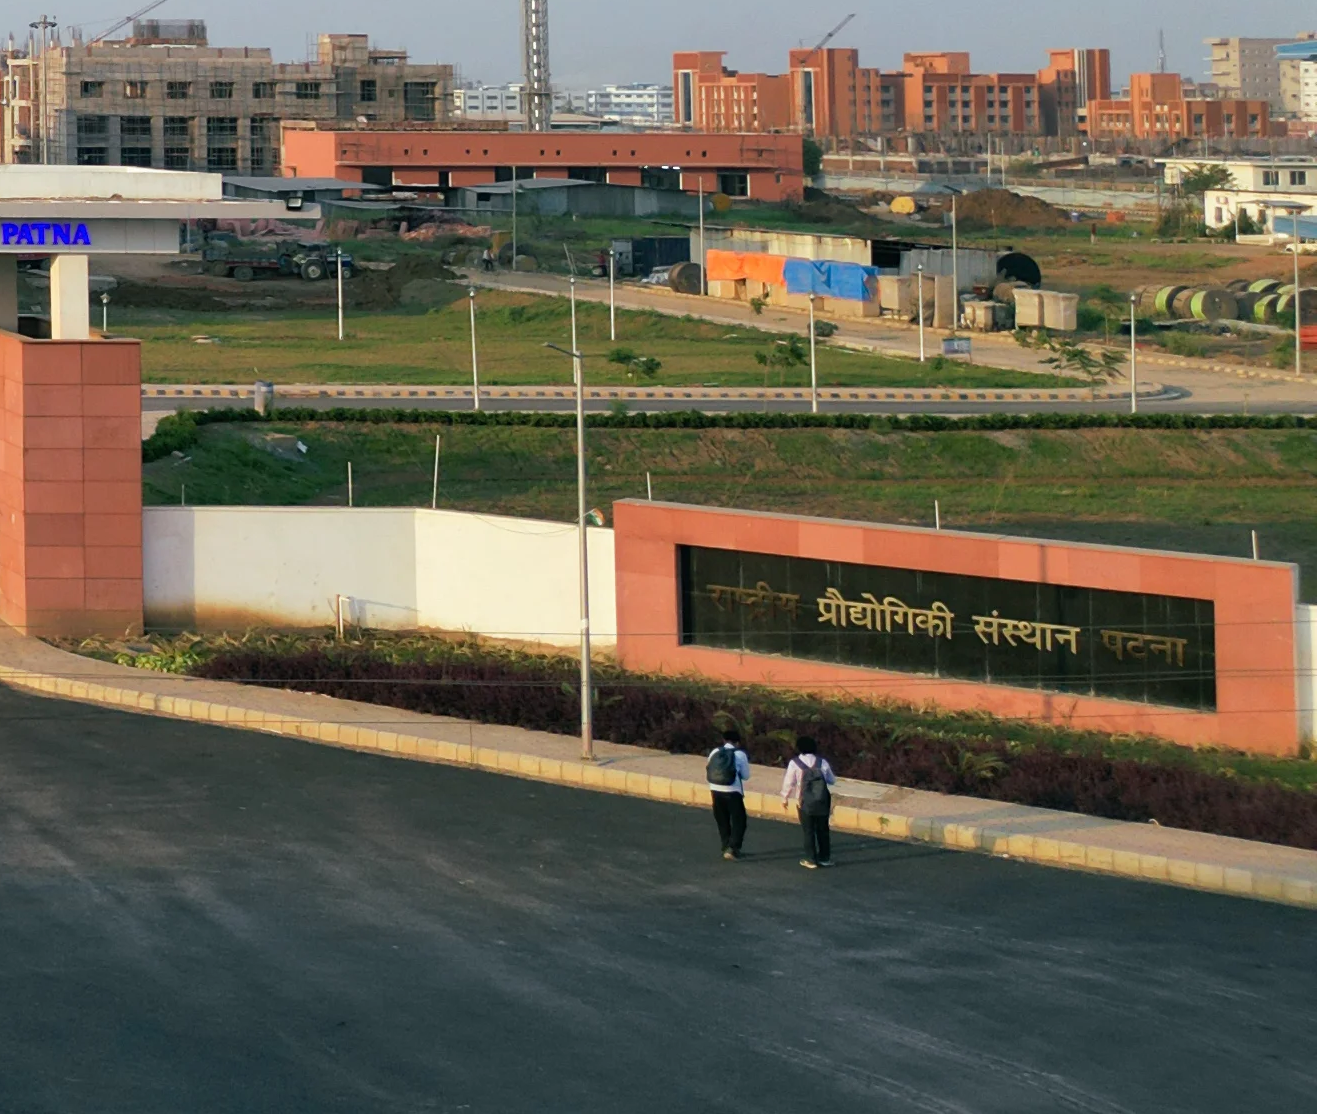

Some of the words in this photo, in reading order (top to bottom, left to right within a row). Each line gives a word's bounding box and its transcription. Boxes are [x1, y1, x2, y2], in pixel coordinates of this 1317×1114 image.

[1, 221, 92, 247] PATNA
[706, 581, 801, 622] राष्ट्रीय
[816, 587, 955, 640] प्रौद्योगिकी
[971, 609, 1082, 655] संस्थान
[1100, 629, 1188, 668] पटना
